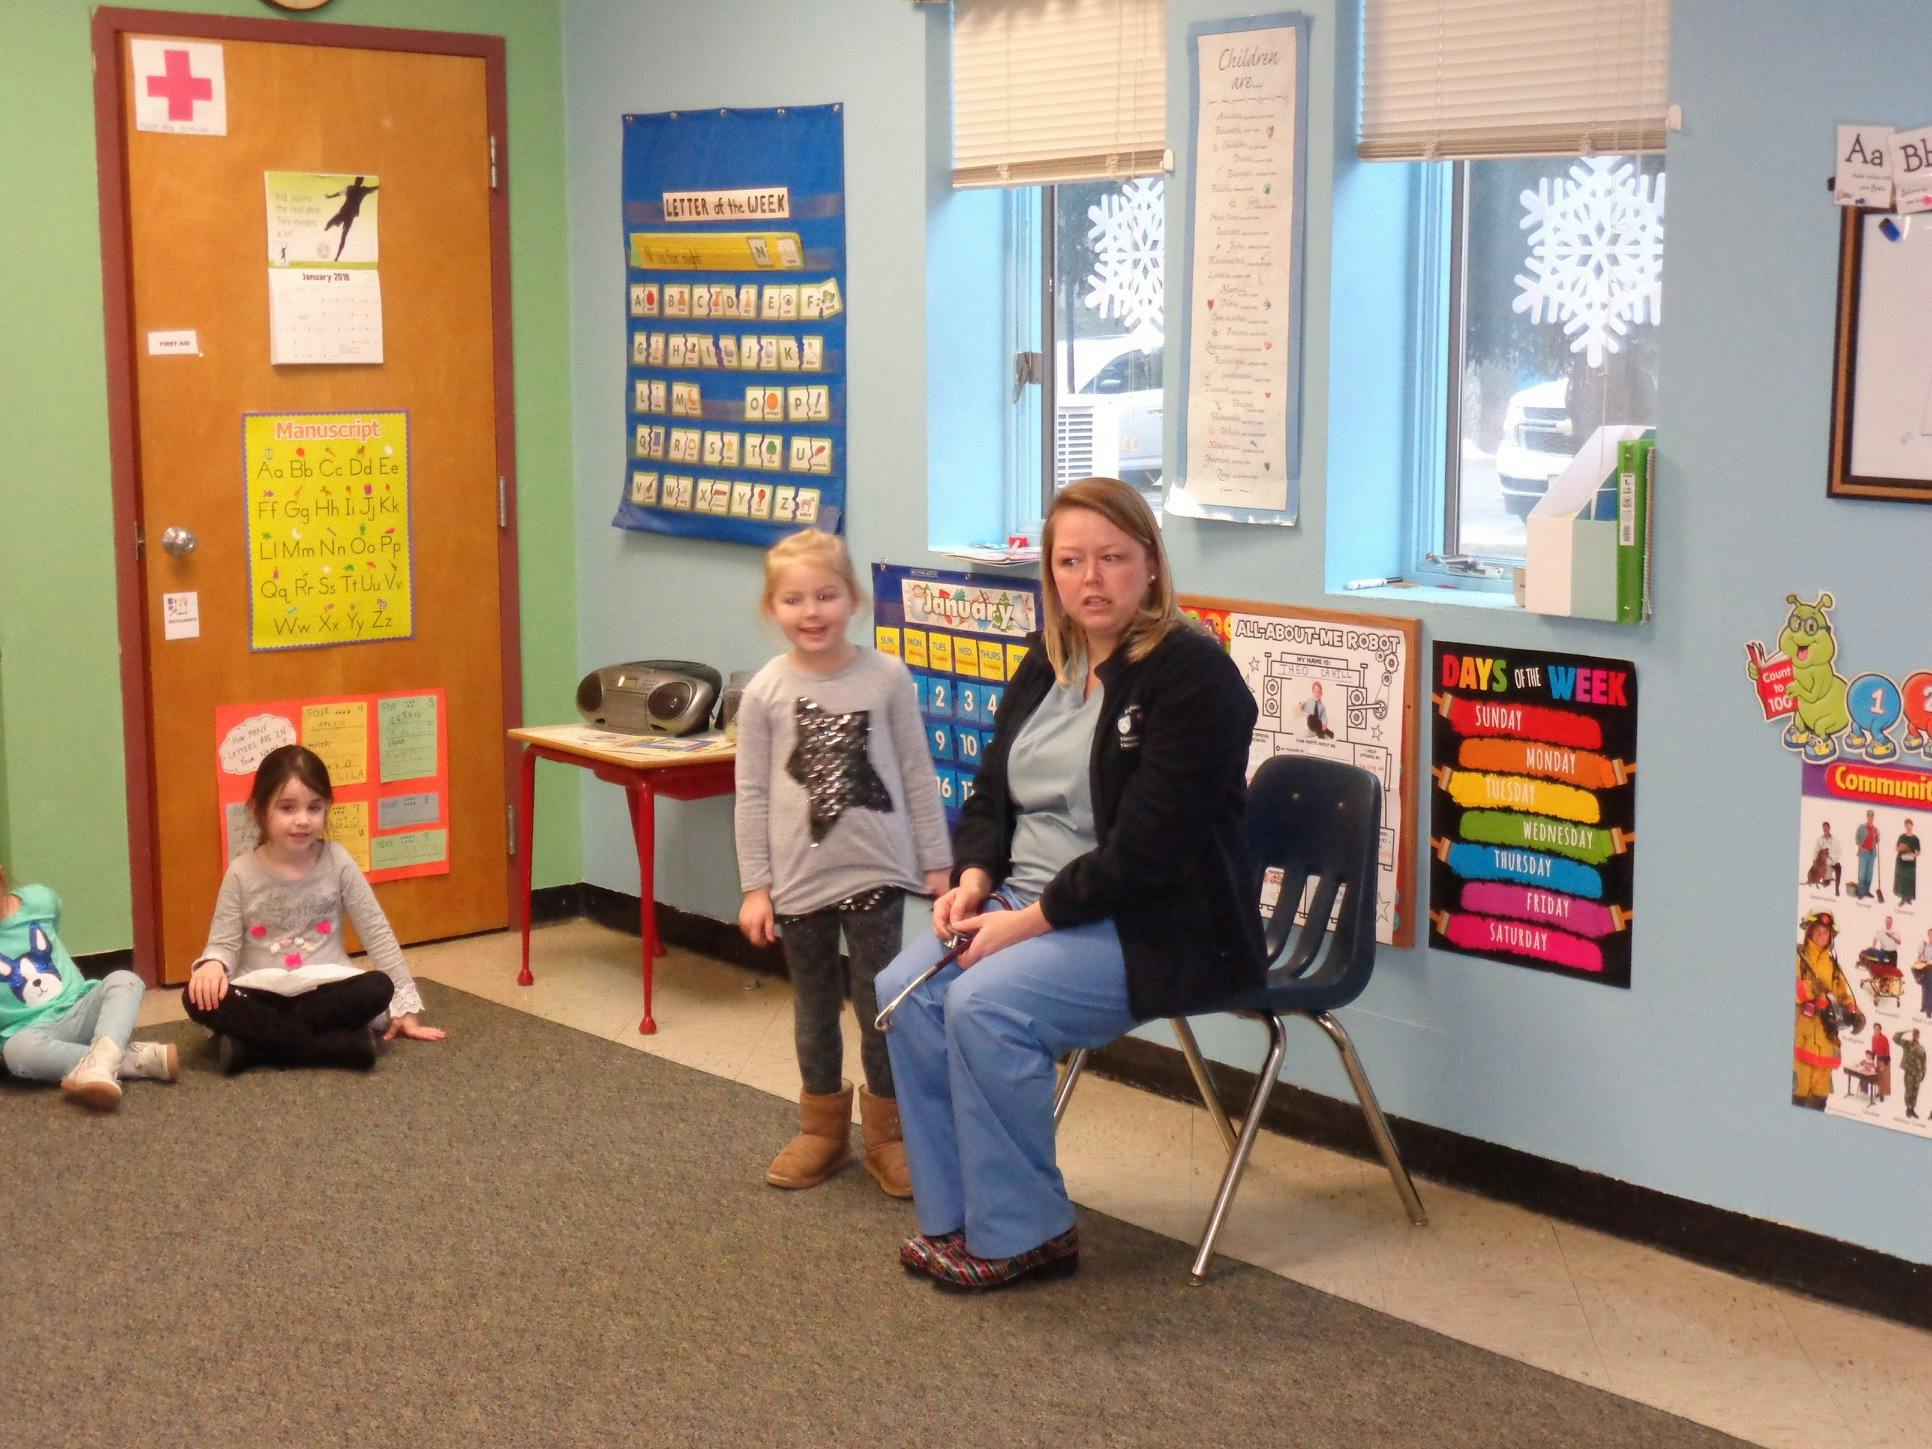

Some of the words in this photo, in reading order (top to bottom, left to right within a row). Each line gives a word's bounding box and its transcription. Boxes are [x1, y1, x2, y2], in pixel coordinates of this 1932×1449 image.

[1218, 45, 1280, 71] Children
[1230, 75, 1262, 91] are...
[1845, 133, 1883, 166] Aa
[666, 198, 709, 217] LETTER
[714, 197, 724, 214] of
[727, 198, 745, 214] the
[747, 194, 785, 213] WEEK
[302, 272, 331, 283] January
[668, 295, 675, 307] B
[697, 296, 704, 308] C
[727, 296, 735, 309] D
[768, 296, 775, 309] E
[807, 295, 814, 309] F
[275, 420, 381, 441] Manuscript
[257, 461, 283, 479] Aa
[290, 460, 313, 478] Bb
[319, 460, 343, 477] Cc
[350, 459, 372, 476] Dd
[379, 457, 399, 475] Ee
[258, 501, 278, 519] Ff
[284, 500, 310, 524] Gg
[315, 500, 339, 518] Hh
[379, 496, 399, 514] Kk
[282, 541, 314, 558] Mm
[320, 539, 346, 556] Nn
[381, 535, 401, 559] Pp
[261, 580, 291, 604] Qq
[295, 578, 313, 597] Rr
[319, 575, 336, 595] Ss
[340, 575, 357, 593] Tt
[361, 574, 380, 592] Uu
[384, 572, 402, 590] Vv
[273, 617, 310, 636] Ww
[319, 615, 339, 632] Xx
[347, 612, 364, 636] Yy
[372, 610, 392, 629] Zz
[923, 587, 1014, 633] January
[1235, 620, 1344, 647] ALL-ABOUT-ME
[1346, 631, 1400, 654] ROBOT
[1443, 655, 1507, 693] DAYS
[1514, 670, 1526, 689] OF
[1526, 667, 1541, 688] THE
[1548, 665, 1628, 707] WEEK
[1762, 667, 1792, 684] Count
[935, 685, 945, 708] 2
[964, 689, 974, 712] 3
[987, 694, 998, 716] 4
[1773, 684, 1785, 694] to
[1870, 688, 1884, 714] 1
[427, 697, 435, 708] 5
[1768, 694, 1793, 713] 100
[1475, 706, 1522, 732] SUNDAY
[935, 730, 946, 752] 9
[960, 733, 978, 757] 10
[1526, 747, 1576, 775] MONDAY
[1486, 779, 1535, 804] TUESDAY
[1523, 821, 1593, 850] WEDNESDAY
[1495, 850, 1551, 877] THURSDAY
[1527, 892, 1569, 918] FRIDAY
[1490, 923, 1547, 951] SATURDAY
